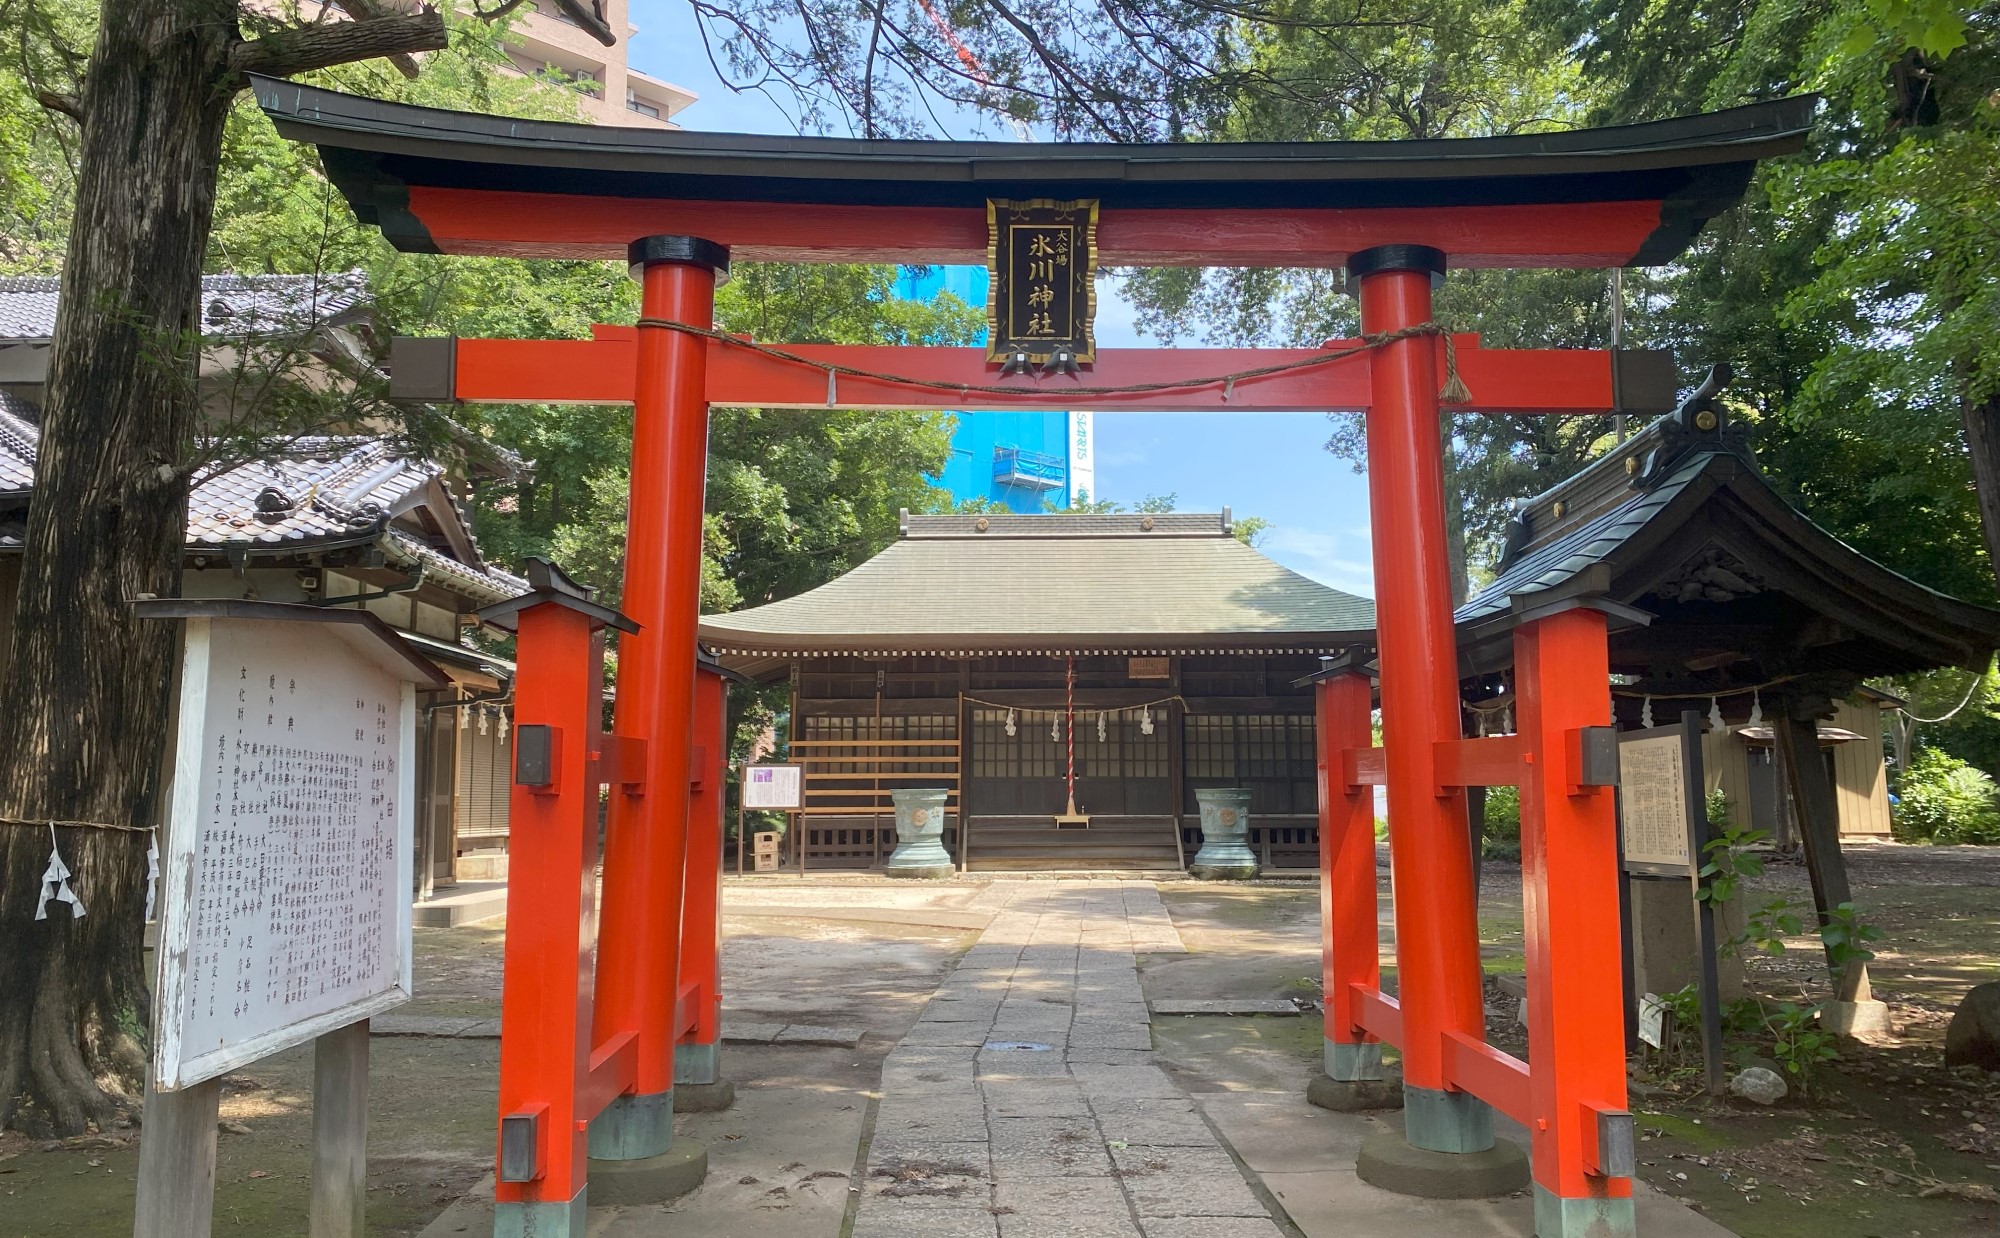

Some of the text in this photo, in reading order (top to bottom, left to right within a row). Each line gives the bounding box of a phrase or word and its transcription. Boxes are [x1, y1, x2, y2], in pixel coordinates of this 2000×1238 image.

[1055, 230, 1068, 266] 大谷場
[1027, 234, 1056, 336] 氷川神社
[237, 666, 246, 721] 文化財
